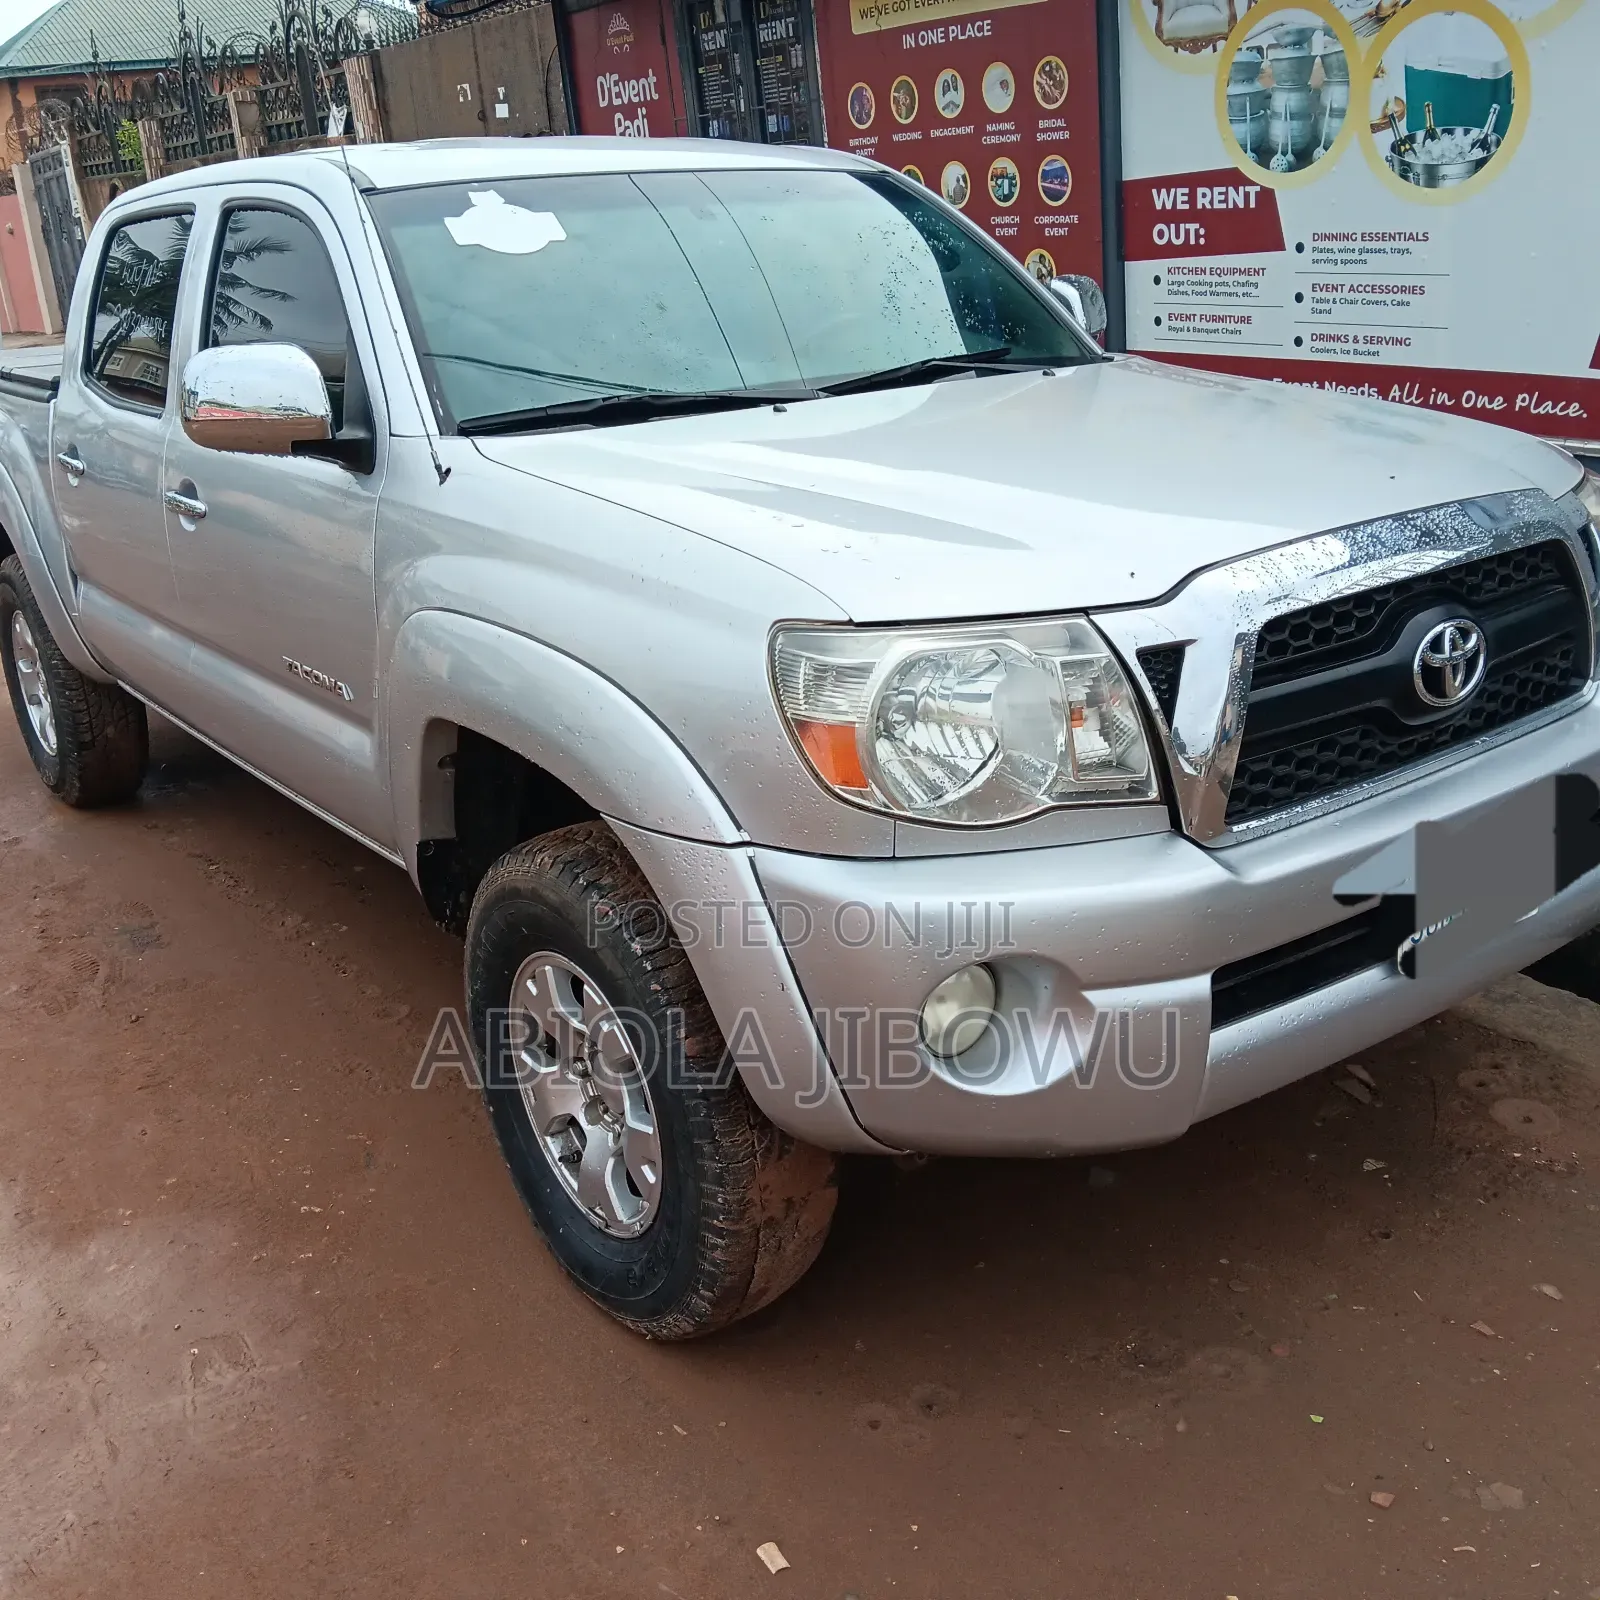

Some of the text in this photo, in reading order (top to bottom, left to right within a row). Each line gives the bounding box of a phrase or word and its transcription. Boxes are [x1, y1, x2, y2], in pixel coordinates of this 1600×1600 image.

[859, 3, 890, 20] WE'VE
[891, 0, 911, 13] GOT
[902, 19, 992, 49] IN ONE PLACE
[596, 68, 660, 108] D'Event
[614, 106, 650, 137] Padi
[986, 121, 1016, 132] NAMING
[1038, 118, 1067, 129] BRIDAL
[892, 131, 923, 142] WEDDING
[930, 125, 975, 138] ENGAGEMENT
[1036, 130, 1070, 142] SHOWER
[849, 136, 879, 147] BIRTHDAY
[981, 133, 1021, 145] CEREMONY
[856, 148, 875, 157] PARTY
[1151, 185, 1262, 211] WE RENT
[990, 215, 1020, 225] CHURCH
[1033, 215, 1079, 225] CORPORATE
[995, 227, 1018, 236] EVENT
[1044, 227, 1069, 236] EVENT
[1152, 222, 1206, 246] OUT:
[1312, 231, 1430, 242] DINNING ESSENTIALS
[1311, 246, 1336, 255] Plates,
[1357, 246, 1389, 256] glasses,
[1390, 246, 1412, 256] trays,
[1311, 256, 1368, 266] serving spoons
[1167, 266, 1267, 277] KITCHEN EQUIPMENT
[1167, 279, 1259, 290] Large Cooking pots, Chafing
[1311, 283, 1426, 295] EVENT ACCESSORIES
[1167, 289, 1190, 297] Dishes,
[1191, 289, 1208, 297] Food
[1208, 290, 1241, 299] Warmers,
[1310, 296, 1411, 307] Table & Chair Covers, Cake
[1310, 307, 1332, 315] Stand
[1167, 312, 1253, 325] EVENT FURNITURE
[1167, 325, 1185, 334] Royal
[1192, 326, 1220, 335] Banquet
[1220, 327, 1242, 336] Chairs
[1310, 332, 1412, 347] DRINKS & SERVING
[1310, 346, 1380, 357] Coolers, Ice Bucket
[1388, 381, 1424, 404] All
[1428, 387, 1455, 406] in
[1461, 389, 1508, 411] One
[1515, 391, 1588, 418] Place.
